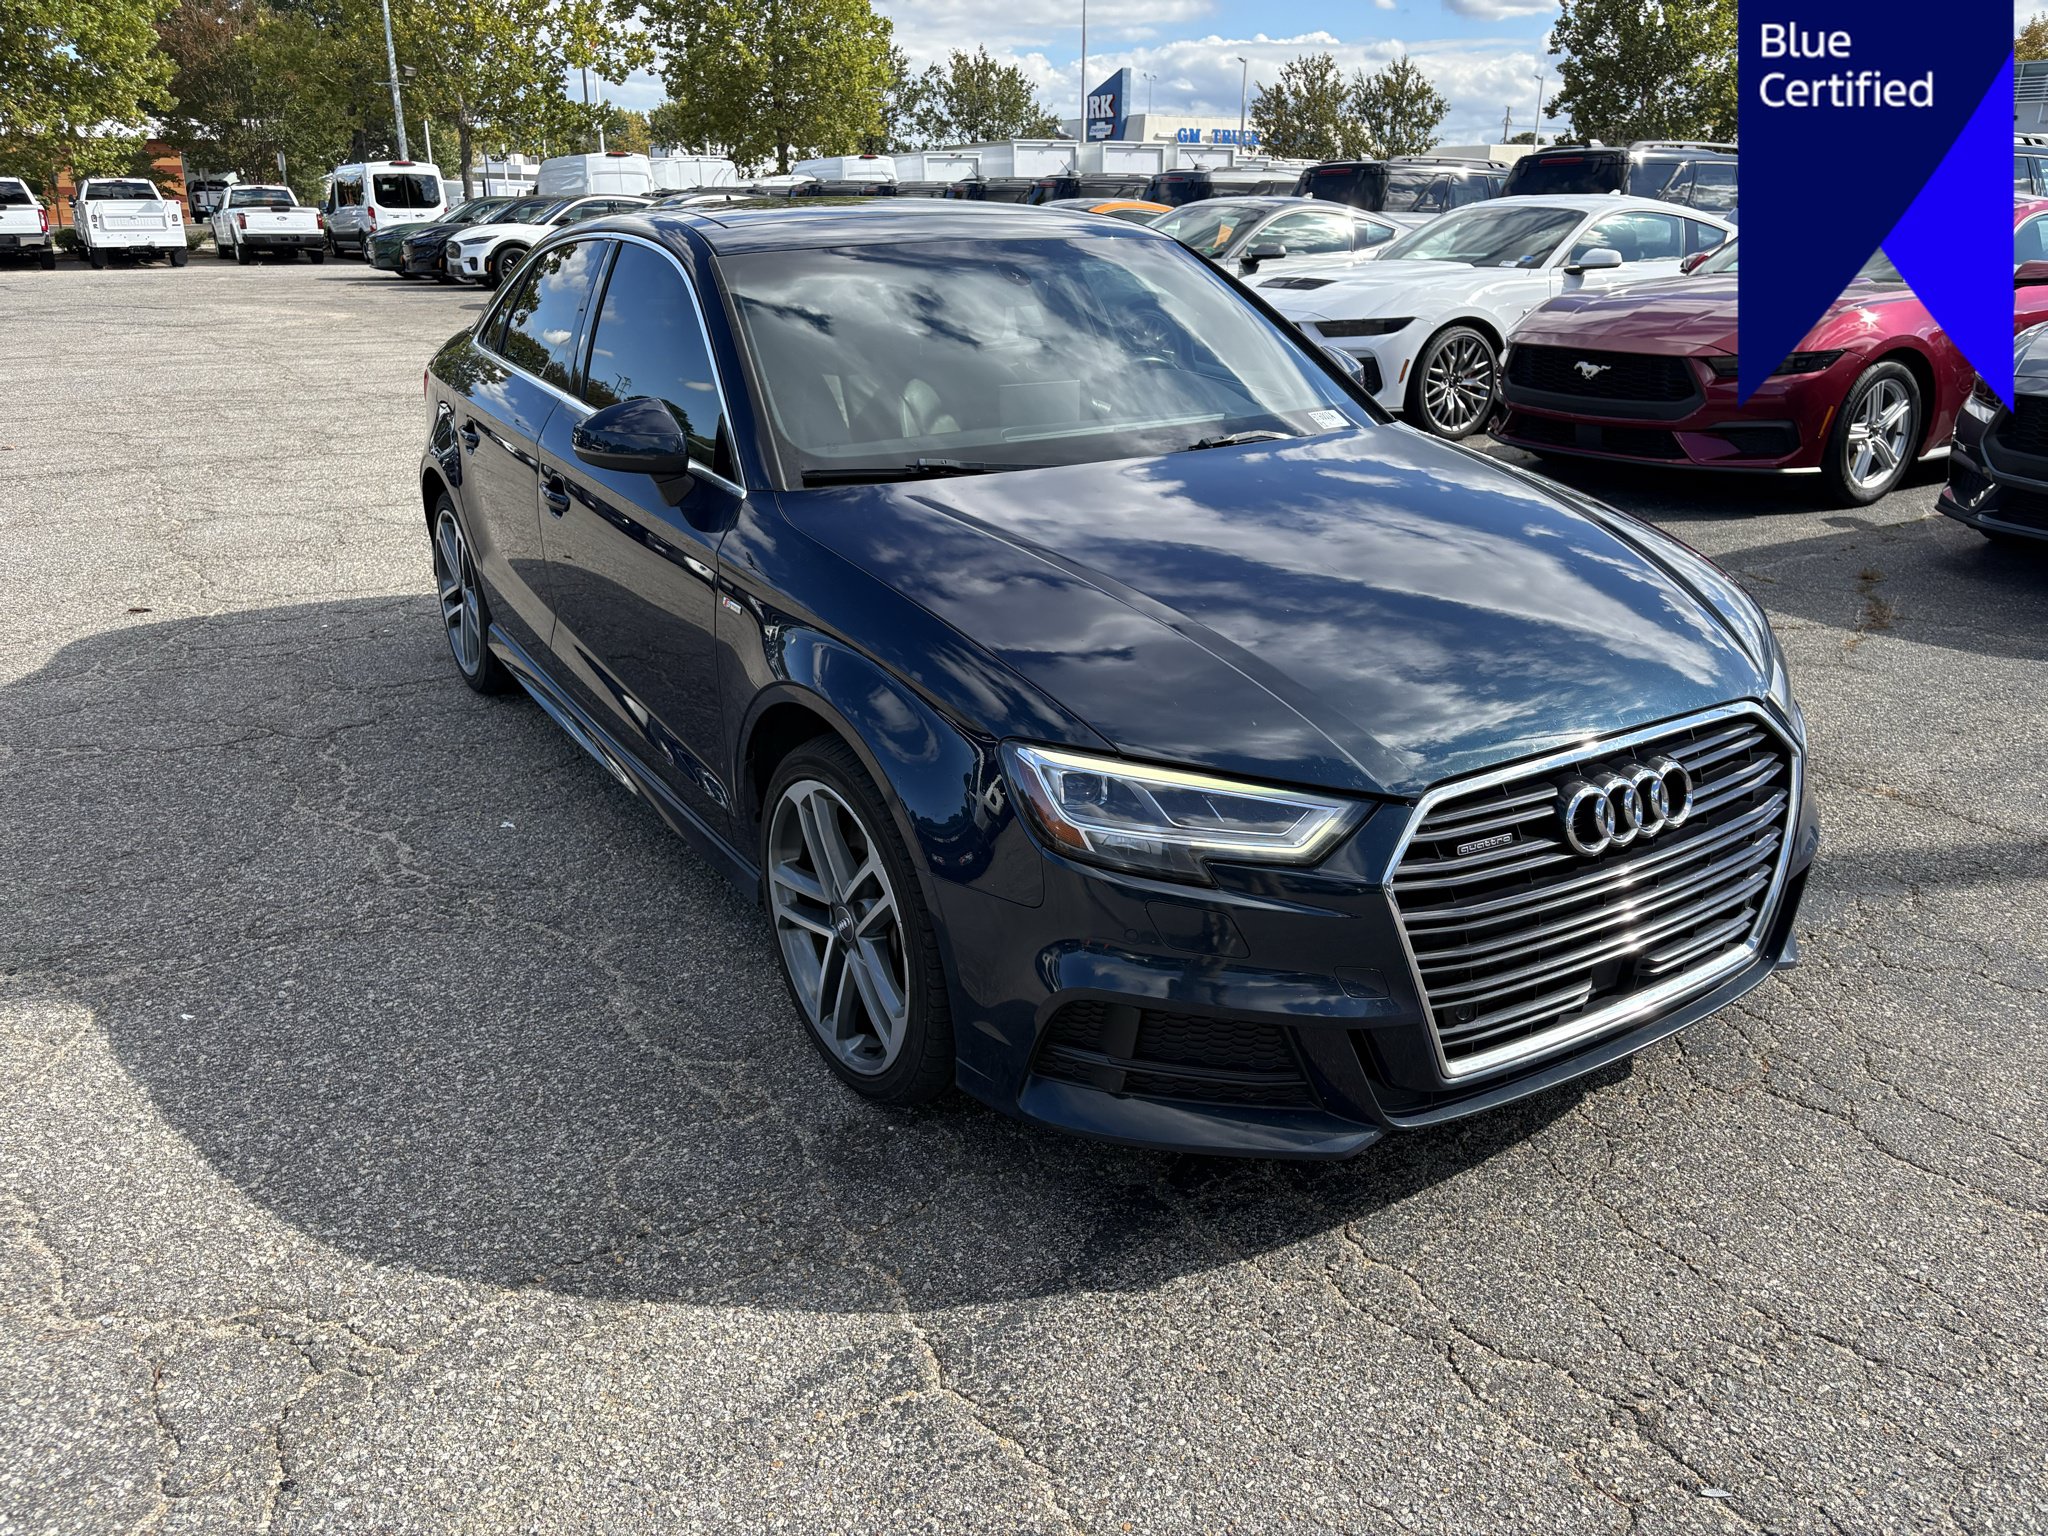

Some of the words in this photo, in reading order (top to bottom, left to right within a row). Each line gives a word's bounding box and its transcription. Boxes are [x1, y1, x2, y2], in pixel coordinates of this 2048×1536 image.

[1089, 94, 1114, 119] RK
[1177, 127, 1201, 143] GM
[1460, 835, 1511, 854] quattro
